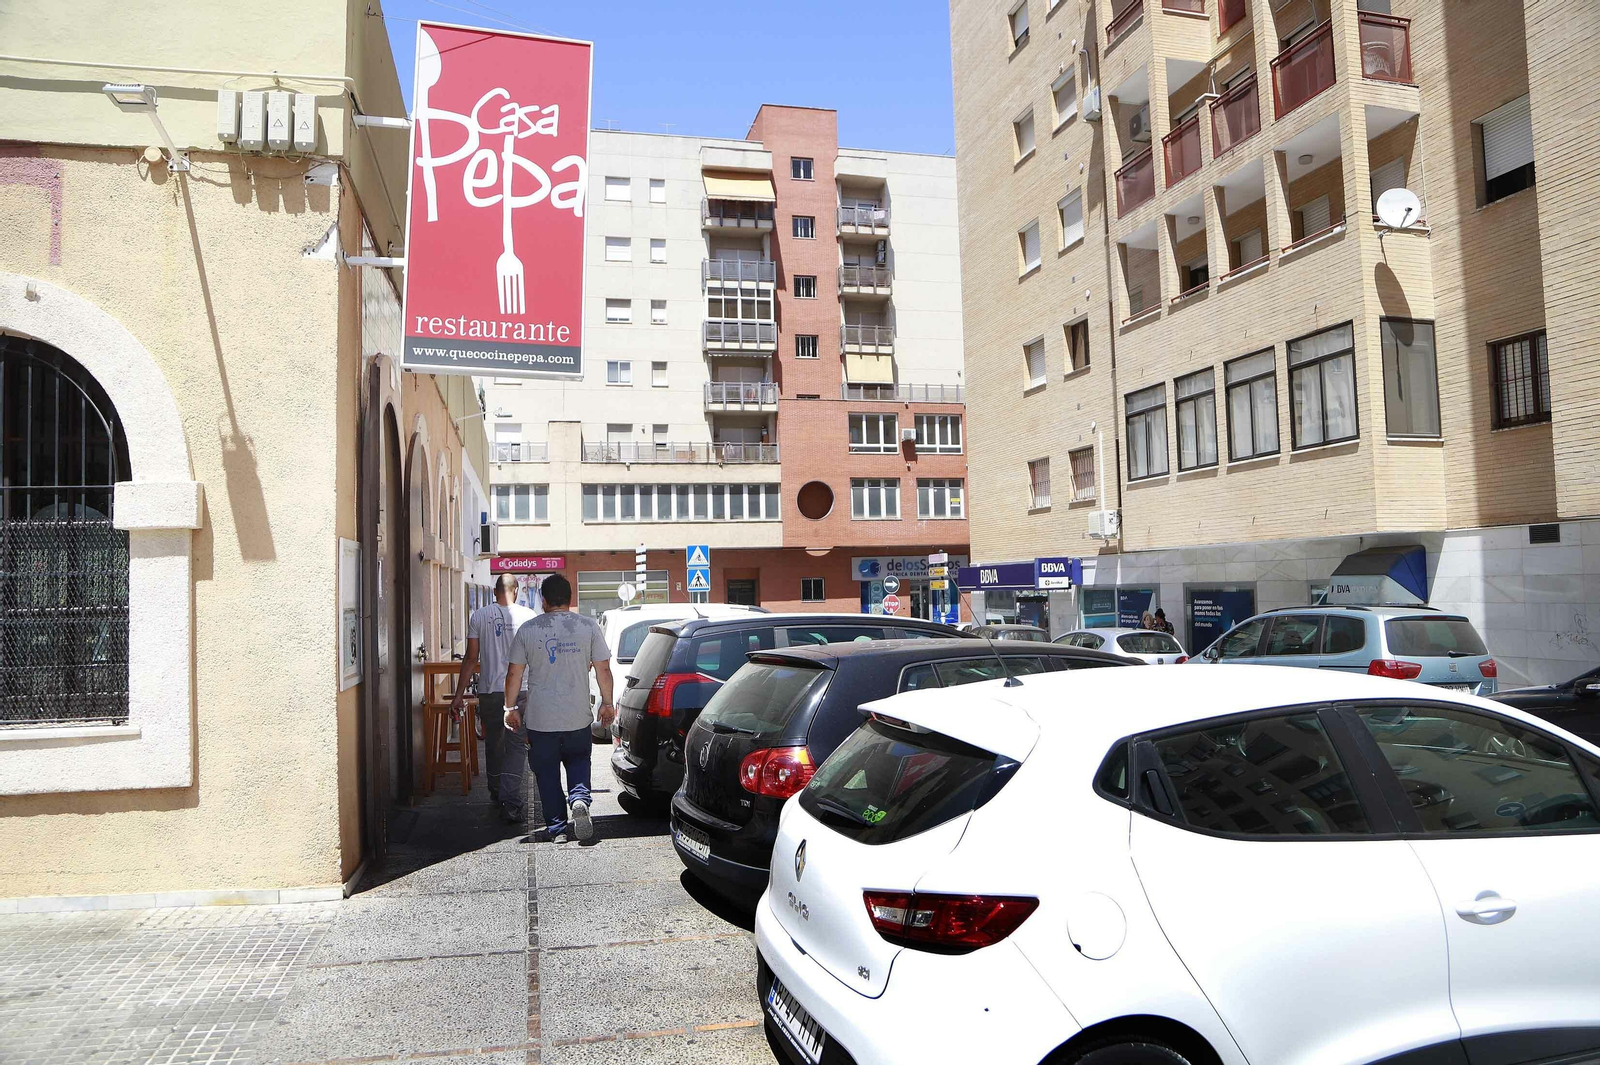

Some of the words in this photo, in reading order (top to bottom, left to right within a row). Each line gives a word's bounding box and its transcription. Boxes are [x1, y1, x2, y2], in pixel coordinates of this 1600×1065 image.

[470, 87, 560, 139] Casa
[415, 85, 587, 250] Pepa
[414, 314, 571, 343] restaurante
[412, 345, 575, 365] www.quecocinepepa.com
[545, 560, 558, 568] 5D
[1041, 562, 1066, 573] BBVA
[980, 568, 999, 584] BBVA
